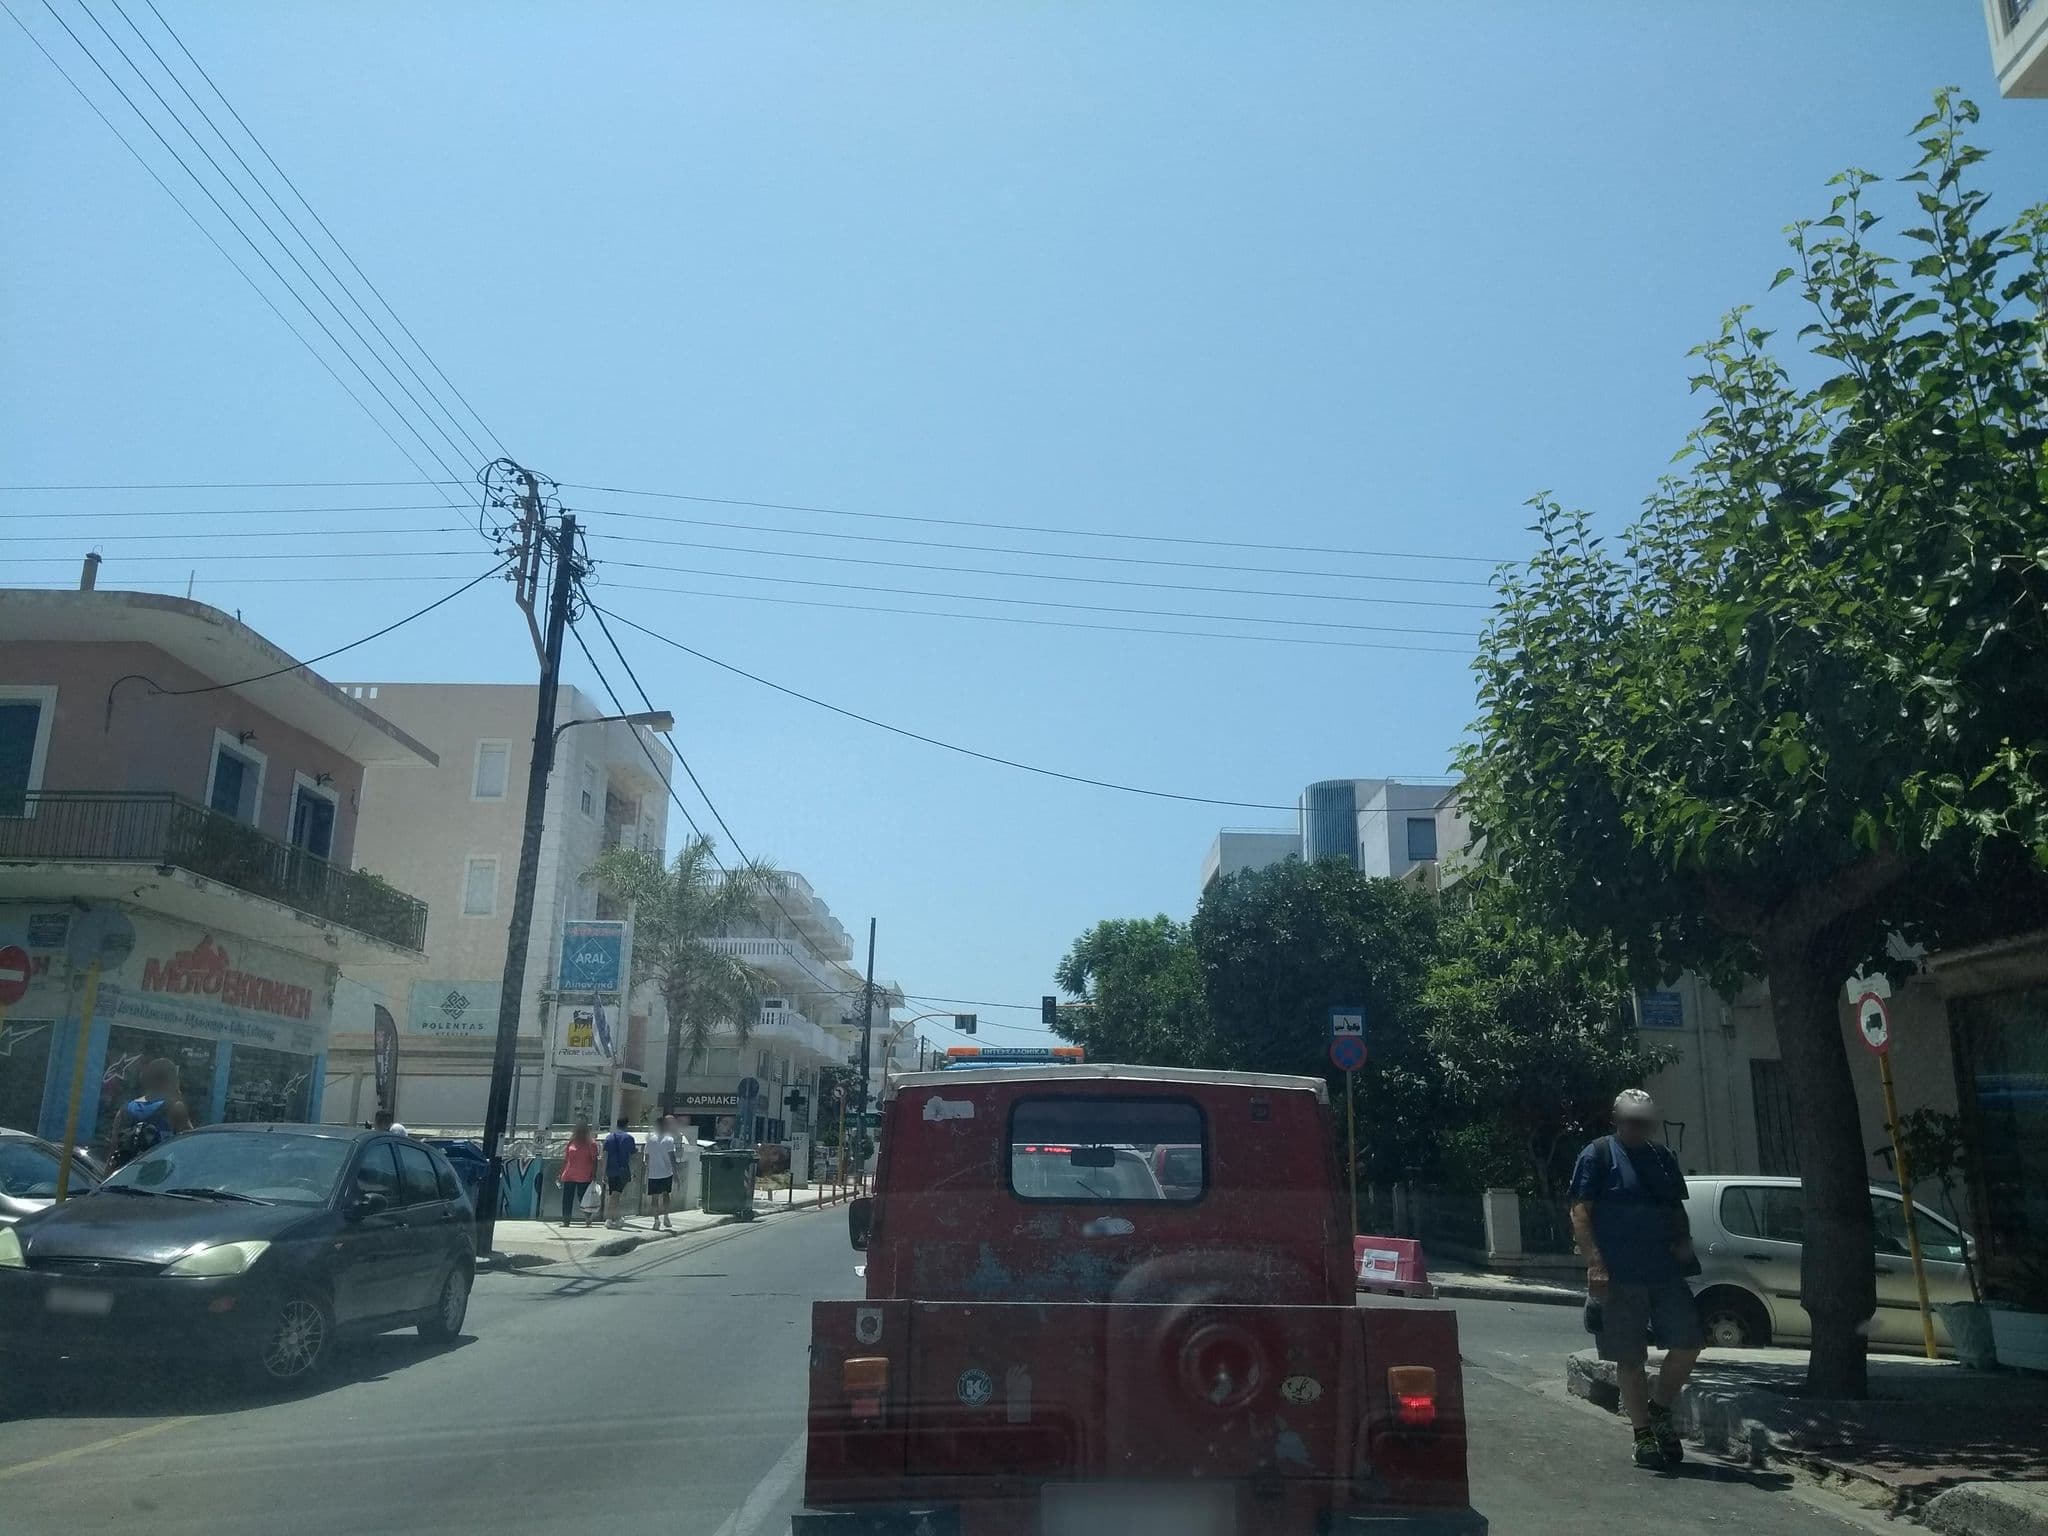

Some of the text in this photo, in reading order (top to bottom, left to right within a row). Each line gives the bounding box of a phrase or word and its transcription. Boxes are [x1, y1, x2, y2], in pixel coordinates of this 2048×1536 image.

[575, 953, 606, 964] ARAL
[422, 1022, 484, 1030] POLENTAS
[569, 1035, 593, 1047] en
[686, 1096, 740, 1105] ΦΑΡΜΑΚΕΙ
